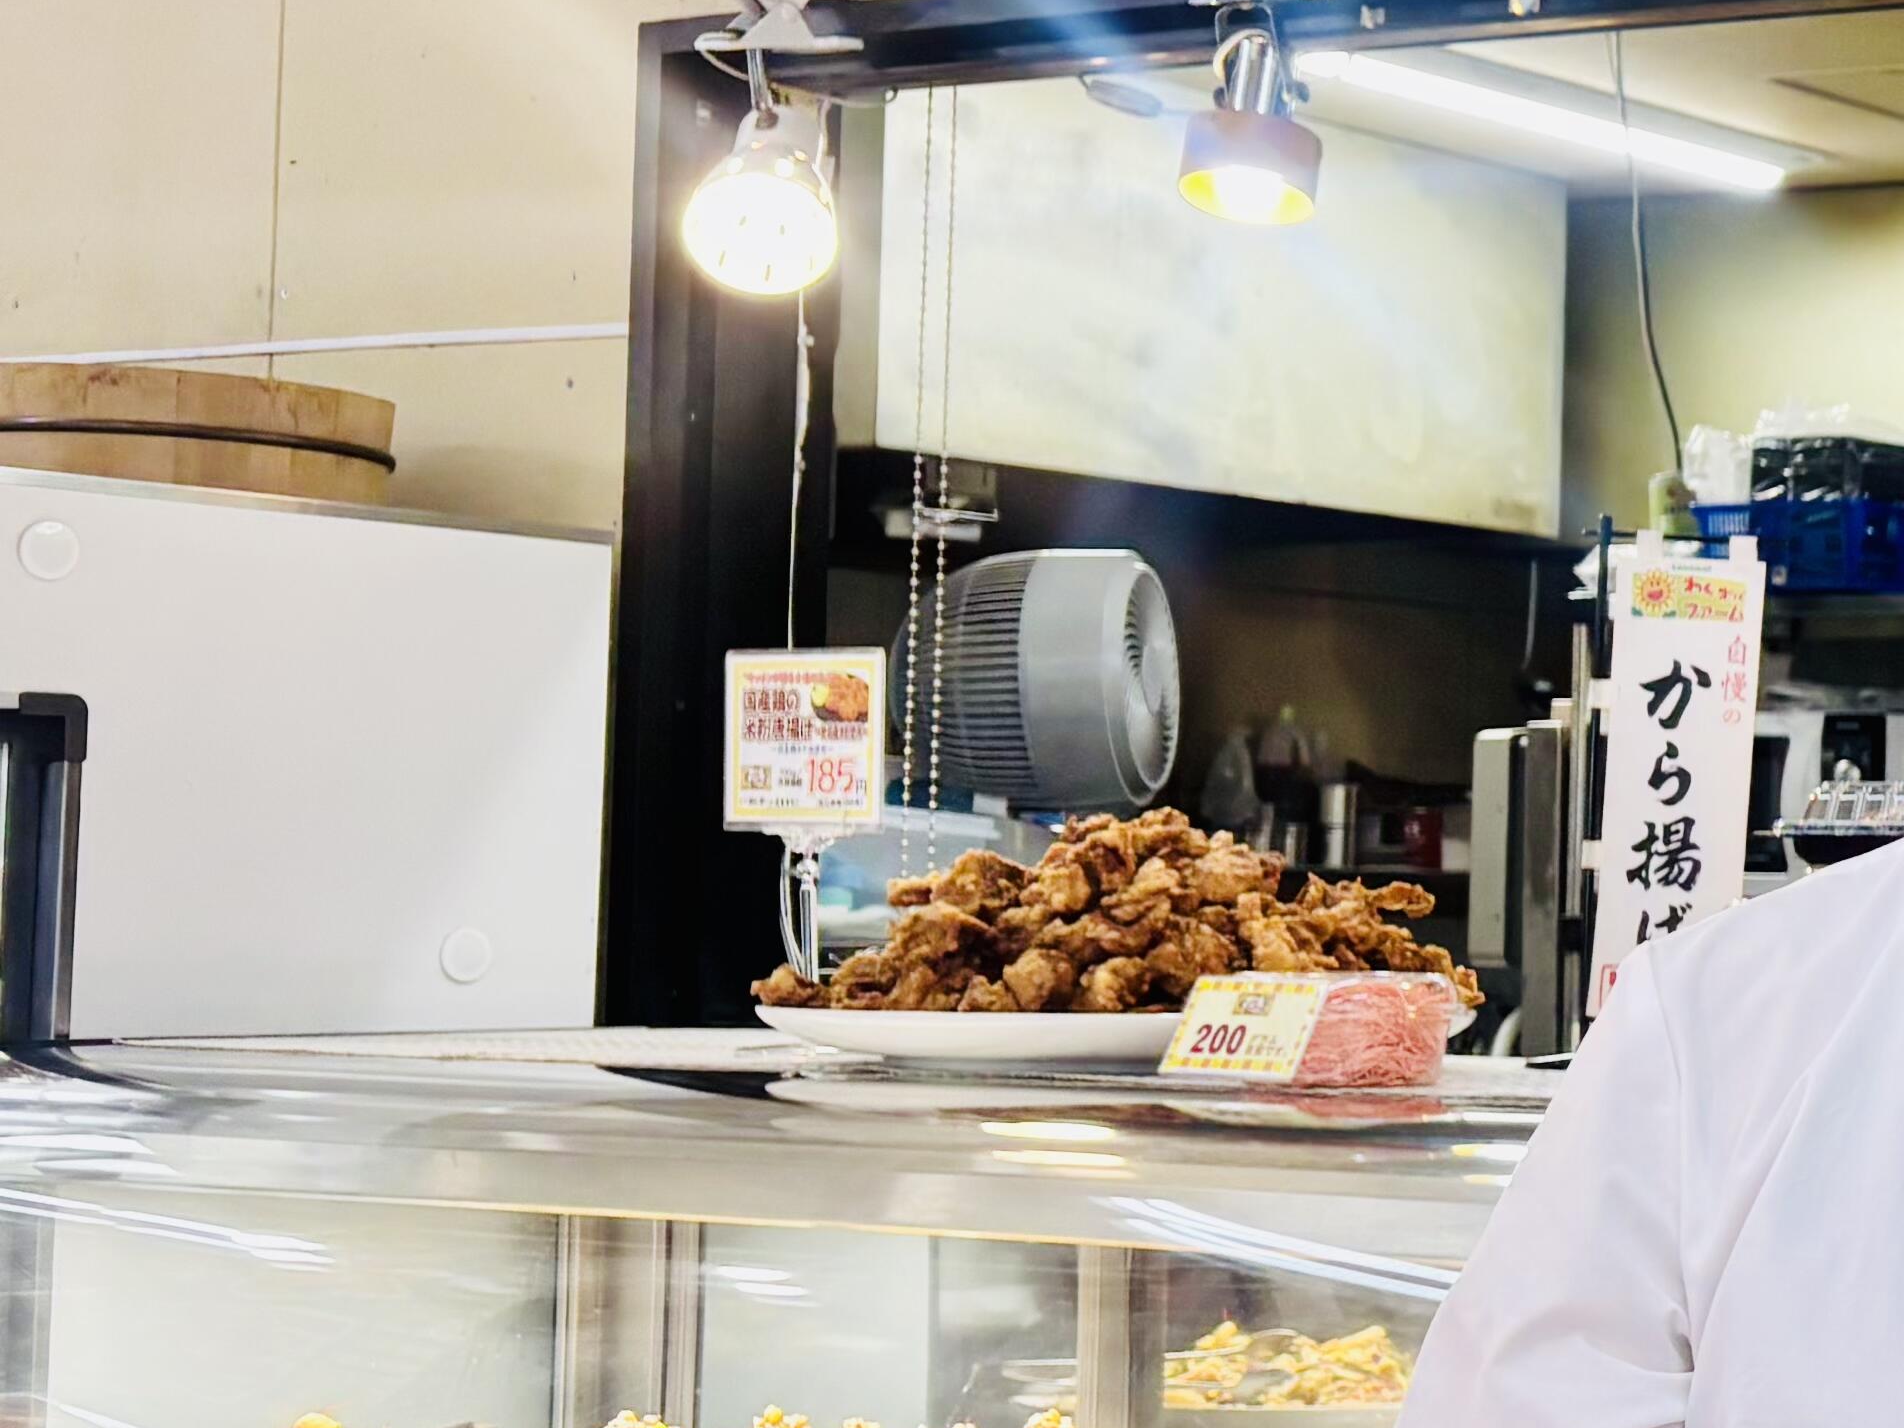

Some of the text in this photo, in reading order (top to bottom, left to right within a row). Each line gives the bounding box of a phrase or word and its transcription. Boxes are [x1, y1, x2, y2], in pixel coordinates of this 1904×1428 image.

[1720, 634, 1747, 725] 自慢の
[1190, 1024, 1247, 1055] 200
